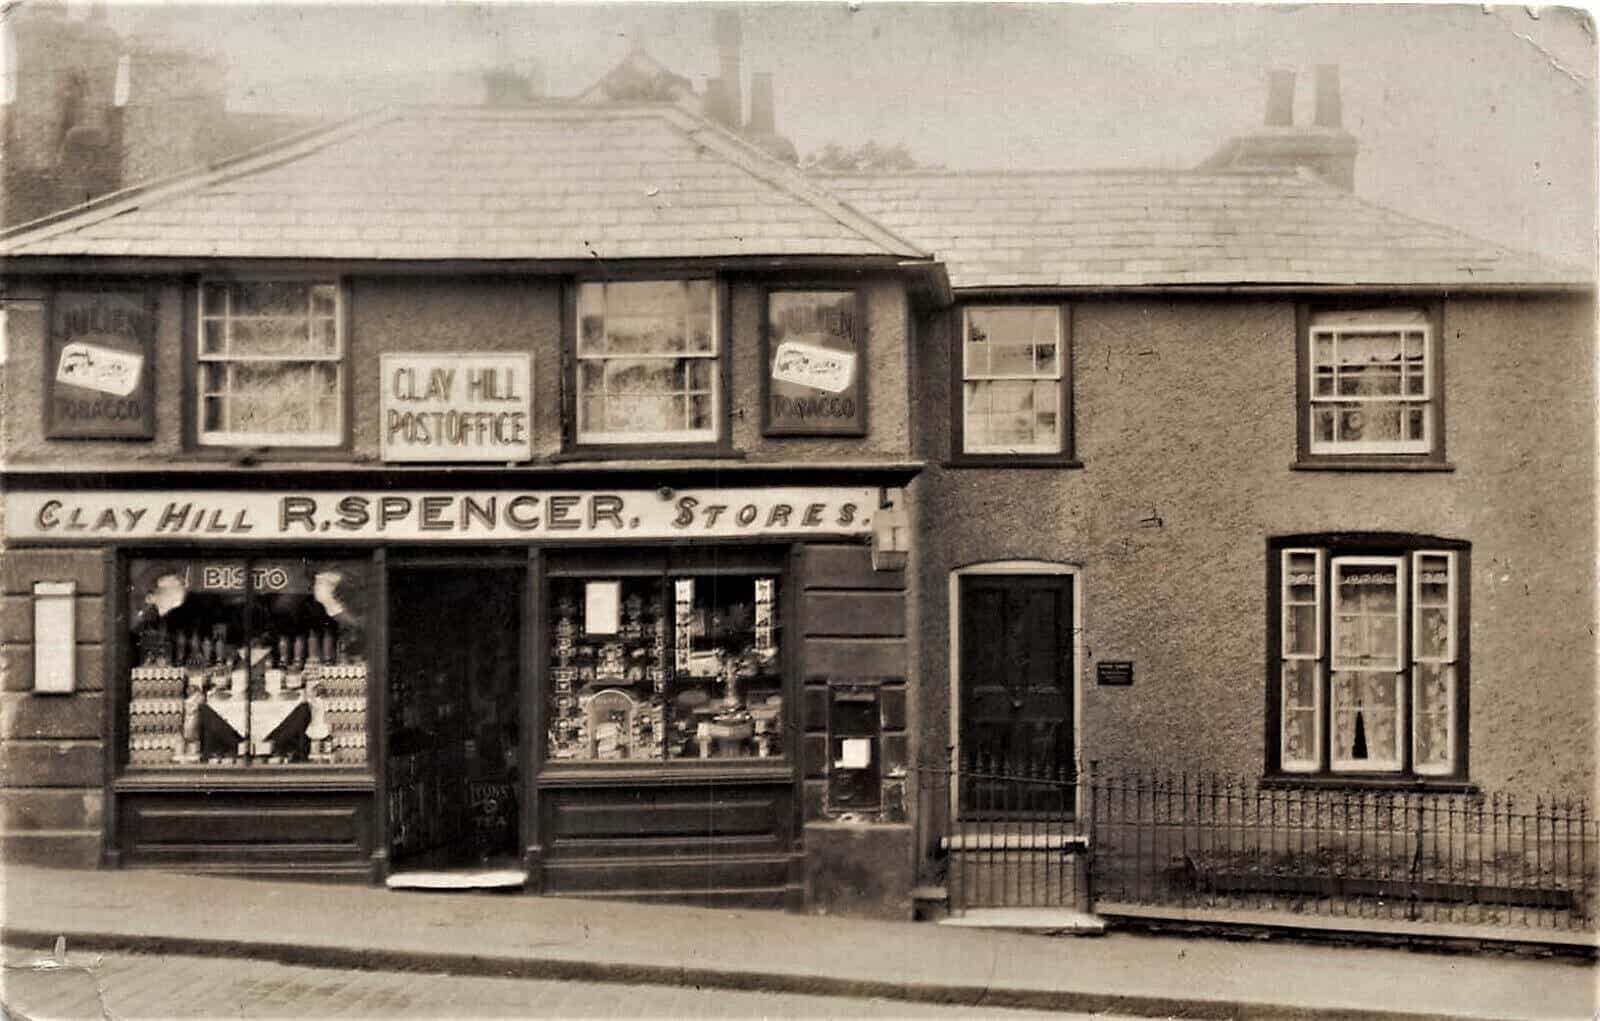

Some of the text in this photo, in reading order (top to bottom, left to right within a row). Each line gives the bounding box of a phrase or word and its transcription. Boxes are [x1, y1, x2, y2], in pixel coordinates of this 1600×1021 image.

[392, 367, 521, 402] CLAY HILL
[54, 398, 142, 422] TOBACCO
[770, 396, 856, 420] TOBACCO
[35, 500, 147, 532] CLAY
[155, 502, 254, 533] HILL
[671, 495, 871, 529] STORES.
[203, 567, 289, 590] BISTO
